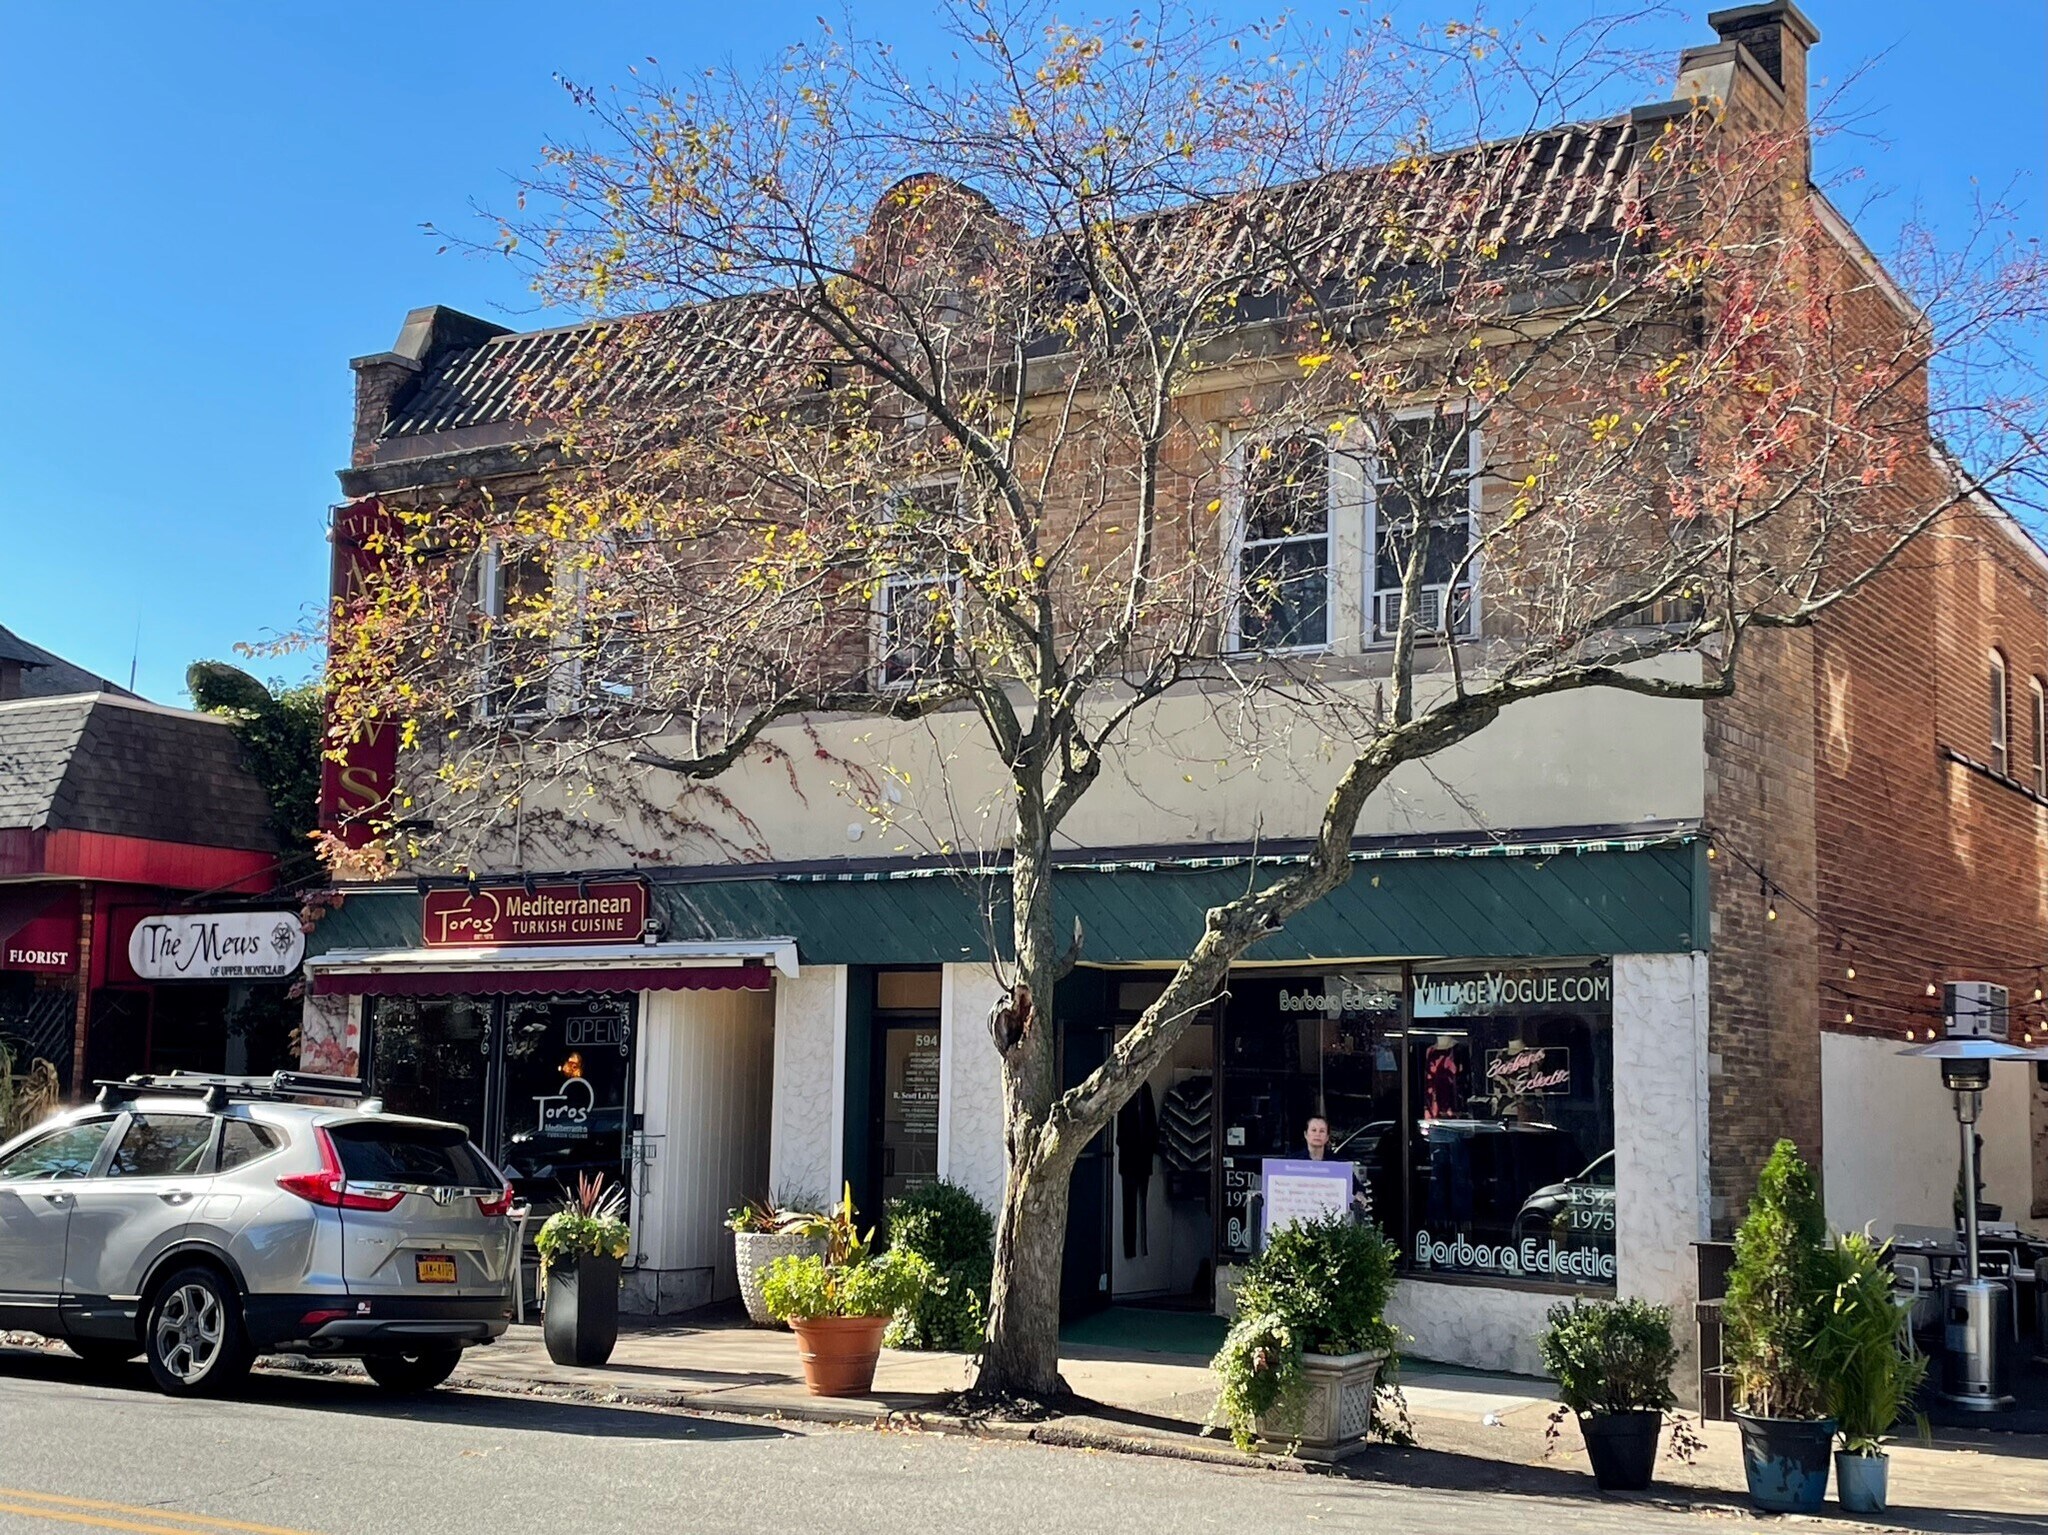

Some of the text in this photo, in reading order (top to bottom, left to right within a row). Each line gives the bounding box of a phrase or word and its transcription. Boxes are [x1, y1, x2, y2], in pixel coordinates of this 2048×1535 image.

[506, 896, 632, 917] Mediterranean
[434, 906, 497, 943] Toros
[512, 918, 624, 934] TURKISH CUISINE
[9, 949, 69, 965] FLORIST
[142, 923, 260, 972] The Mews
[221, 965, 243, 976] UPPER
[244, 965, 286, 976] MONTCLAIR
[1279, 988, 1397, 1011] Barbara Eclectic
[568, 1019, 621, 1043] OPEN
[915, 1034, 938, 1047] 594
[532, 1093, 588, 1132] Toros
[1570, 1210, 1615, 1231] 1975
[1415, 1230, 1615, 1278] Barbara Eclectic
